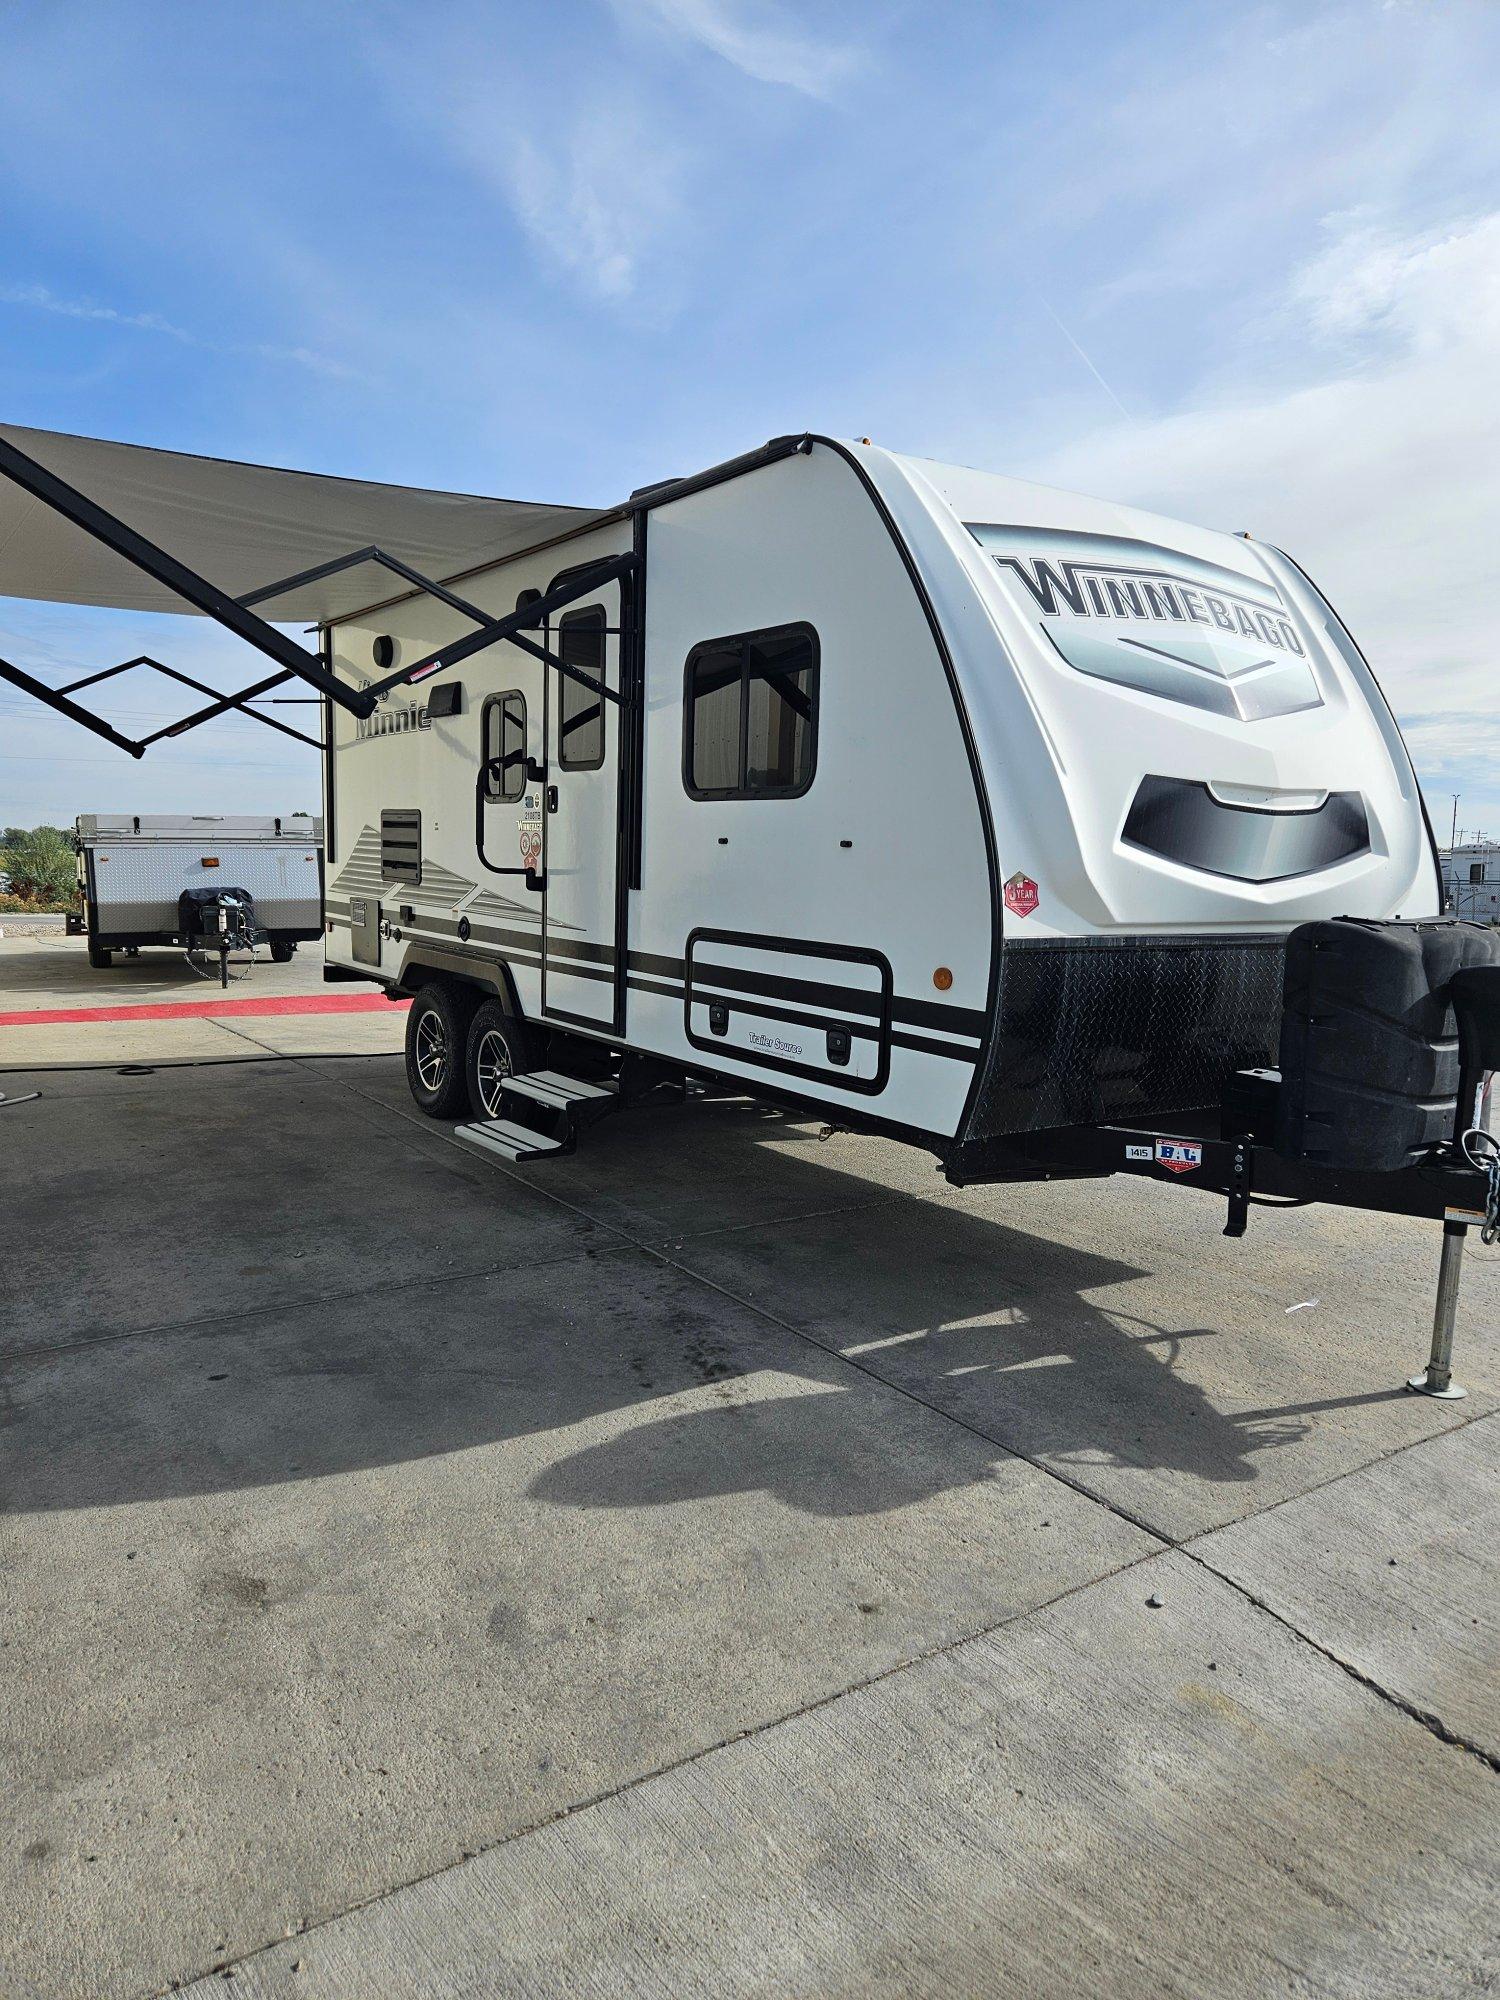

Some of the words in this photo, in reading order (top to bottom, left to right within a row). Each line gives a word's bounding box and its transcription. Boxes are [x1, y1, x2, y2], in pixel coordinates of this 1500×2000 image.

[992, 554, 1307, 659] WINNEBAGO
[1016, 889, 1034, 899] YEAR
[749, 1031, 774, 1048] Trailer
[774, 1037, 803, 1055] Source
[1130, 1148, 1148, 1157] 1415
